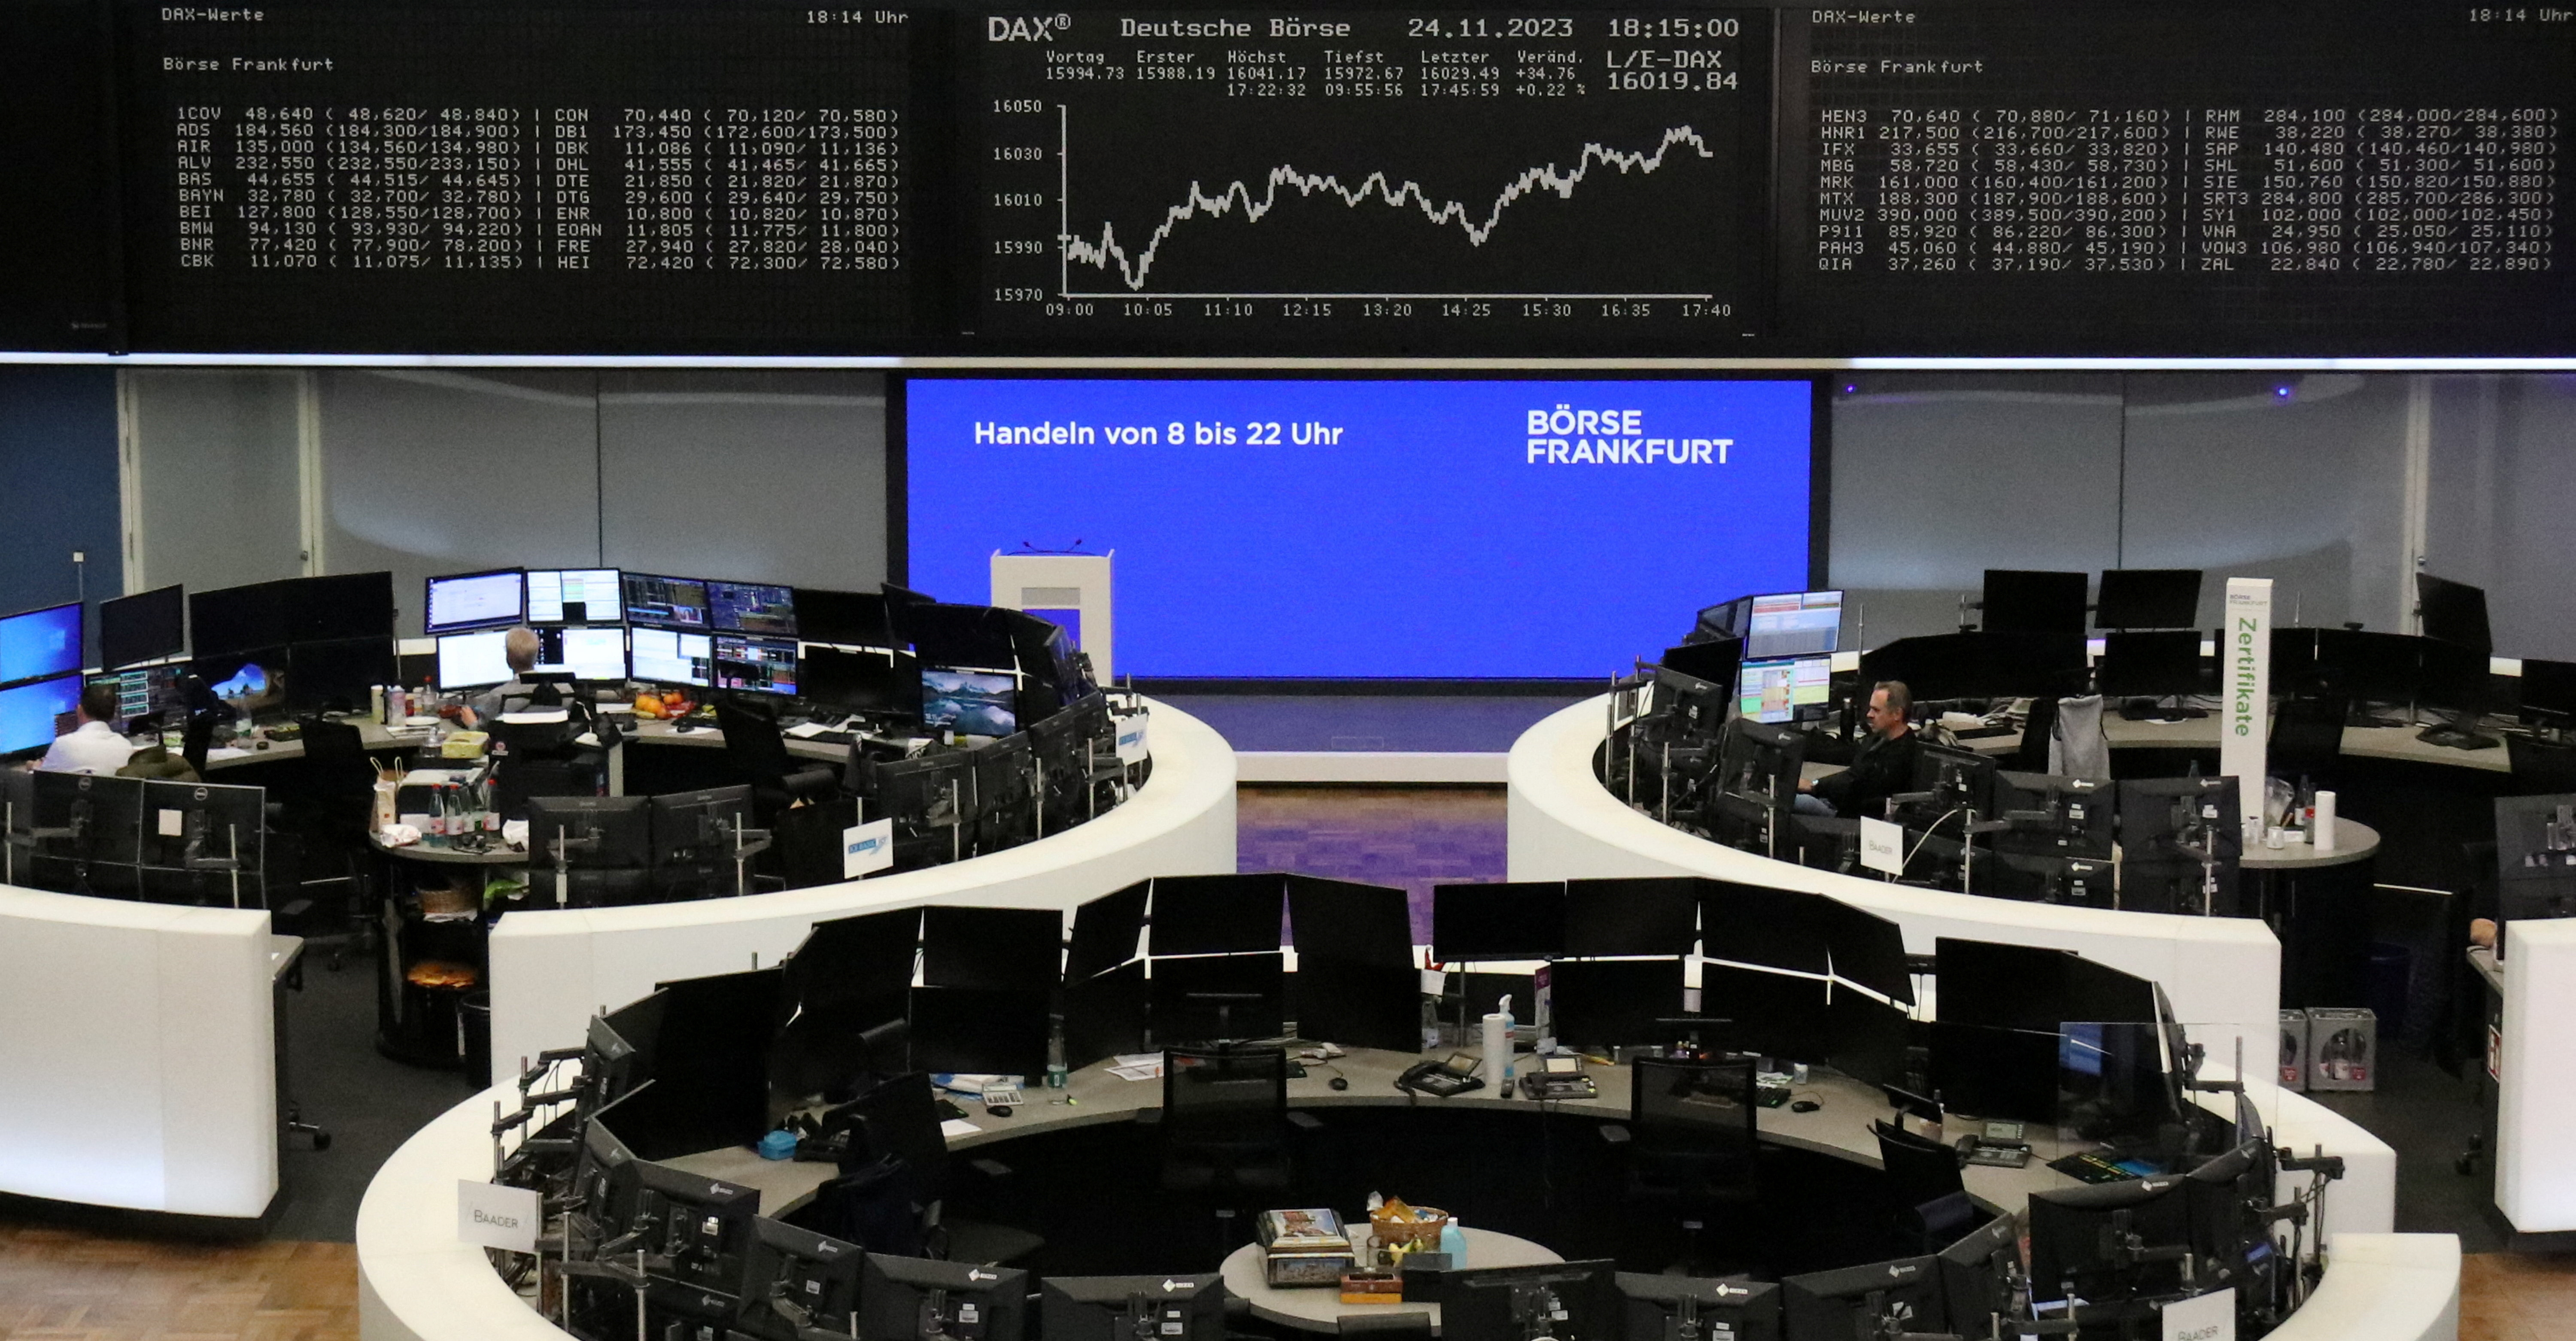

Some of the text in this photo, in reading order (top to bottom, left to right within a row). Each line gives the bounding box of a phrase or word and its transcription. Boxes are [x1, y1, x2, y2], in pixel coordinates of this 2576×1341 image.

[162, 7, 264, 21] DAX-Werte
[808, 10, 908, 24] 18:14 Uhr
[1812, 10, 1915, 23] DAX-Werte
[2470, 8, 2573, 22] 18:14 Uhr
[1121, 18, 1251, 37] Deutsche
[1270, 17, 1351, 37] Börse
[1409, 18, 1573, 38] 24.11.2023
[1609, 18, 1739, 39] 18:15:00
[163, 57, 333, 71] Börse Frankfurt
[1046, 50, 1582, 65] Vortag Erster Höchst Tiefst Letzter Veränd.
[1607, 50, 1722, 68] L/E-DAX
[1047, 66, 1575, 80] 15994.73 15988.19 16041.17 15972.67 16029.49 +34.76
[1811, 60, 1983, 73] Börse Frankfurt
[1608, 71, 1738, 91] 16019.84
[1228, 83, 1585, 97] 17:22:32 09:55:56 17:45:59 +0.22 %
[178, 106, 313, 120] 1COV 48,640
[994, 99, 1042, 113] 16050
[555, 108, 691, 122] CON 70,440
[1822, 109, 1960, 123] HEN3 70,640
[2206, 109, 2345, 122] RHM 284,100
[177, 123, 210, 137] ADS
[236, 123, 313, 137] 184,560
[555, 124, 587, 138] DB1
[614, 125, 691, 139] 173,450
[1821, 126, 1865, 139] HNR1
[1879, 126, 1959, 140] 217,500
[2205, 125, 2345, 139] RWE 38,220
[177, 139, 314, 153] AIR 135,000
[556, 141, 692, 155] DBK 11,086
[1823, 142, 1959, 156] IFX 33,655
[2205, 142, 2344, 156] SAP 140,480
[994, 147, 1042, 161] 16030
[178, 155, 211, 169] ALV
[236, 156, 314, 170] 232,550
[556, 158, 692, 171] DHL 41,555
[1821, 159, 1959, 172] MBG 58,720
[2204, 158, 2343, 172] SHL 51,600
[178, 172, 315, 186] BAS 44,655
[556, 174, 692, 188] DTE 21,850
[1820, 175, 1958, 189] MRK 161,000
[2204, 175, 2343, 188] SIE 150,760
[179, 188, 315, 202] BAYN 32,780
[556, 190, 693, 204] DTG 29,600
[994, 193, 1042, 206] 16010
[1820, 192, 1958, 205] MTX 188,300
[2203, 191, 2342, 205] SRT3 284,800
[179, 205, 316, 219] BEI 127,800
[557, 206, 693, 221] ENR 10,800
[1820, 208, 1957, 221] MUV2 390,000
[2203, 208, 2234, 221] SY1
[2263, 208, 2342, 221] 102,000
[180, 221, 316, 235] BMW 94,130
[557, 223, 693, 237] EOAN 11,805
[1819, 225, 1957, 238] P911 85,920
[2202, 225, 2341, 238] VNA 24,950
[180, 237, 316, 252] BNR 77,420
[557, 239, 693, 253] FRE 27,940
[995, 240, 1042, 254] 15990
[1819, 241, 1956, 255] PAH3 45,060
[2202, 241, 2340, 255] VOW3 106,980
[181, 254, 317, 267] CBK 11,070
[558, 255, 693, 269] HEI 72,420
[1819, 257, 1956, 271] QIA 37,260
[2201, 257, 2340, 271] ZAL 22,840
[995, 288, 1042, 301] 15970
[1046, 303, 1731, 317] 09:00 10:05 11:10 12:15 13:20 14:25 15:30 16:35 17:40
[1528, 404, 1642, 435] BÖRSE
[975, 421, 1344, 445] Handeln von 8 bis 22 Uhr
[1528, 439, 1734, 464] FRANKFURT
[2236, 617, 2257, 736] Zertifikate
